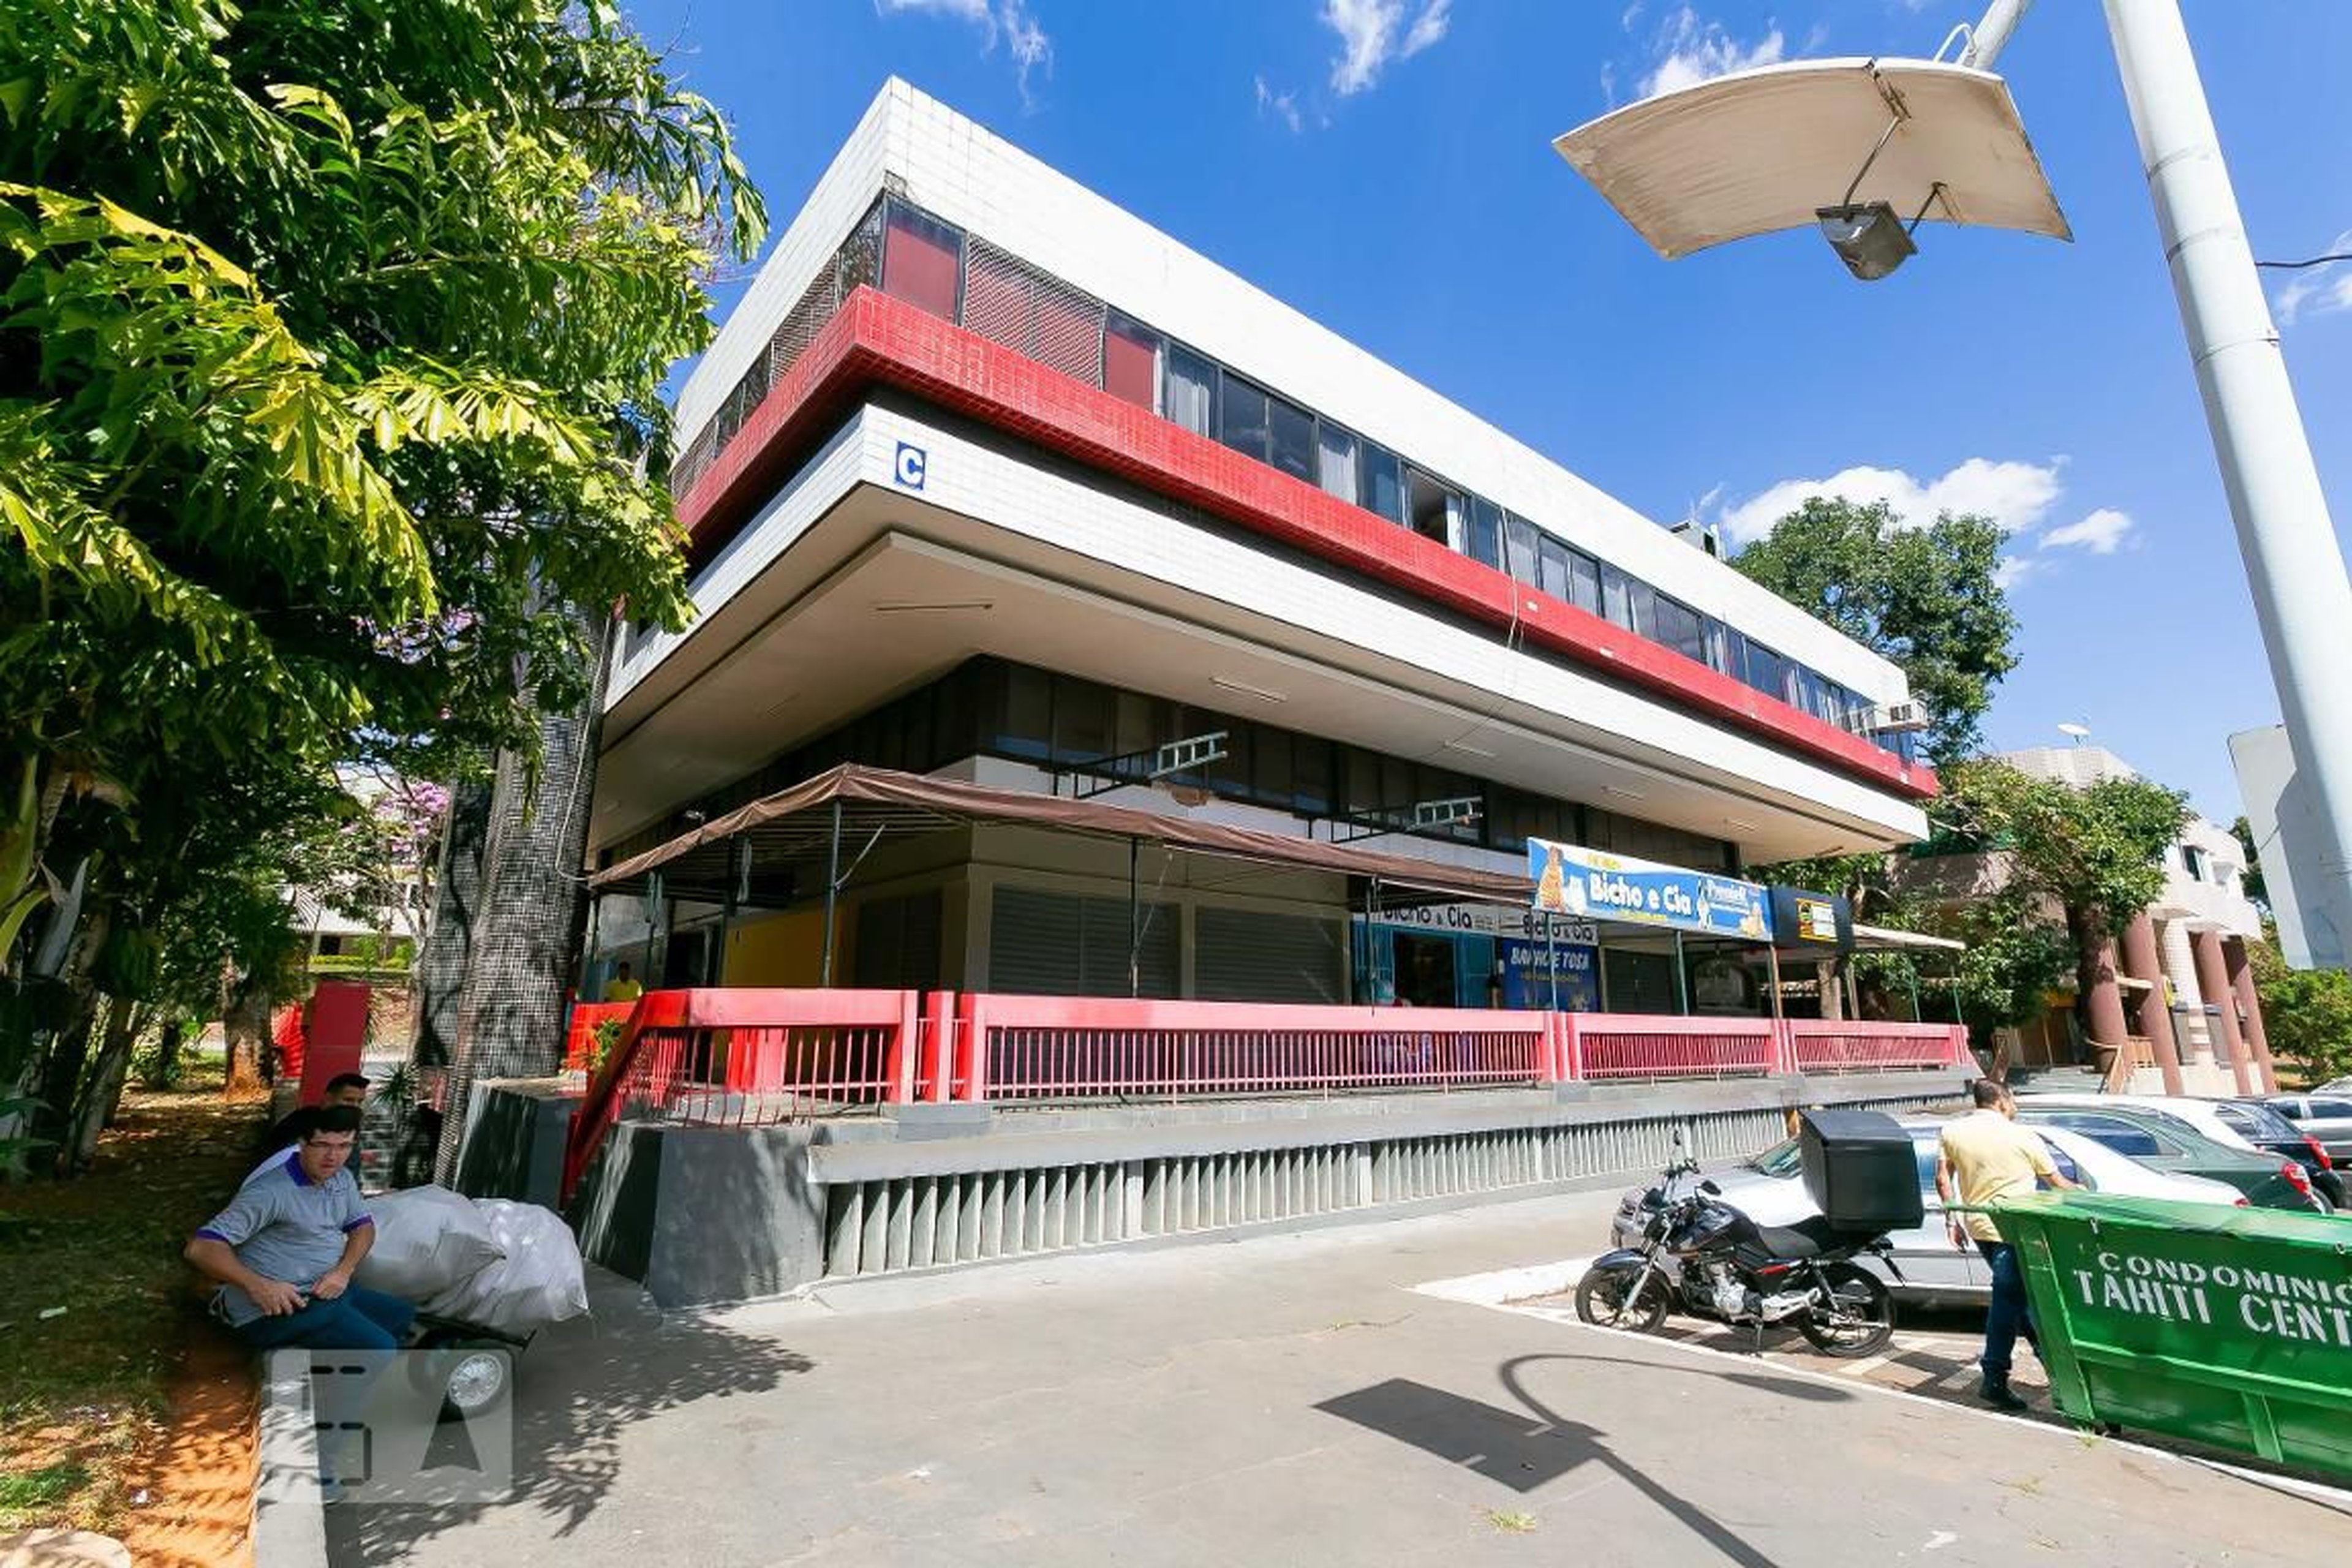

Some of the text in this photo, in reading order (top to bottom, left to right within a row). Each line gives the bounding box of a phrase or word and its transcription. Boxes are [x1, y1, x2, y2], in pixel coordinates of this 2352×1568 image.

[899, 448, 923, 486] C
[1589, 872, 1643, 909] Bicho
[1664, 884, 1692, 916] Cia
[1447, 906, 1472, 929] Cia
[1562, 952, 1589, 970] TOSA
[2073, 1269, 2211, 1324] TAHITI
